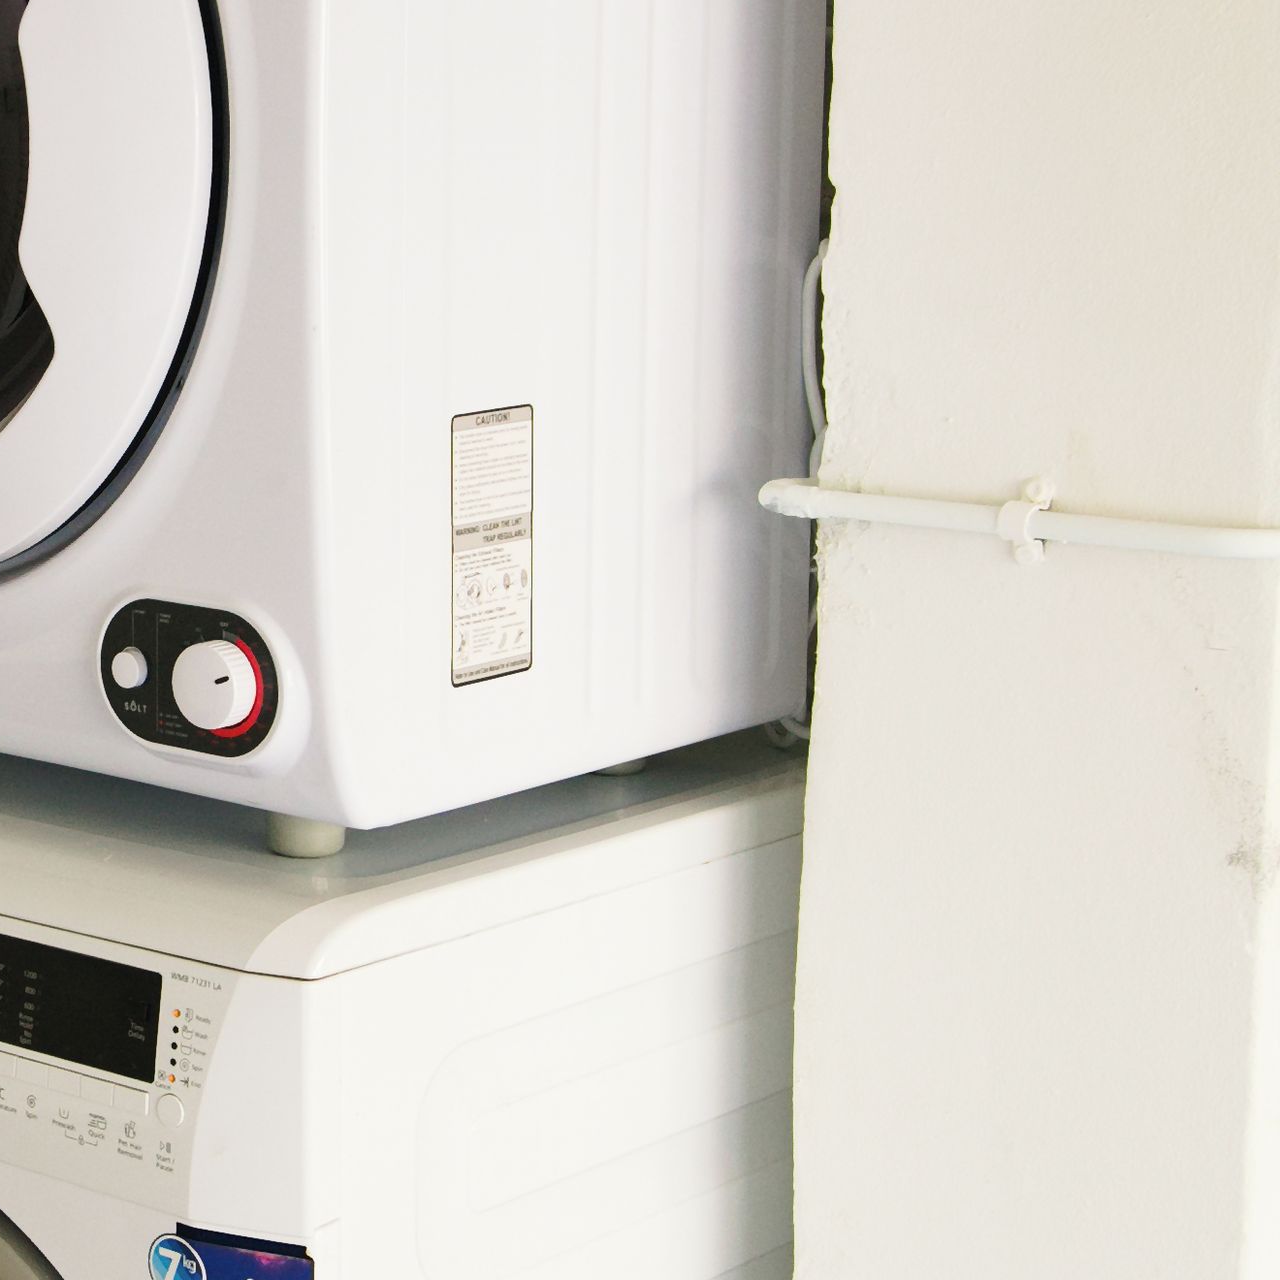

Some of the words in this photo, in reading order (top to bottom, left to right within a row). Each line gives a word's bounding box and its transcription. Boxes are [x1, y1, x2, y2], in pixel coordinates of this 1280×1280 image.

[475, 411, 510, 426] CAUTION!
[171, 972, 189, 983] WMB
[191, 977, 211, 989] 71231
